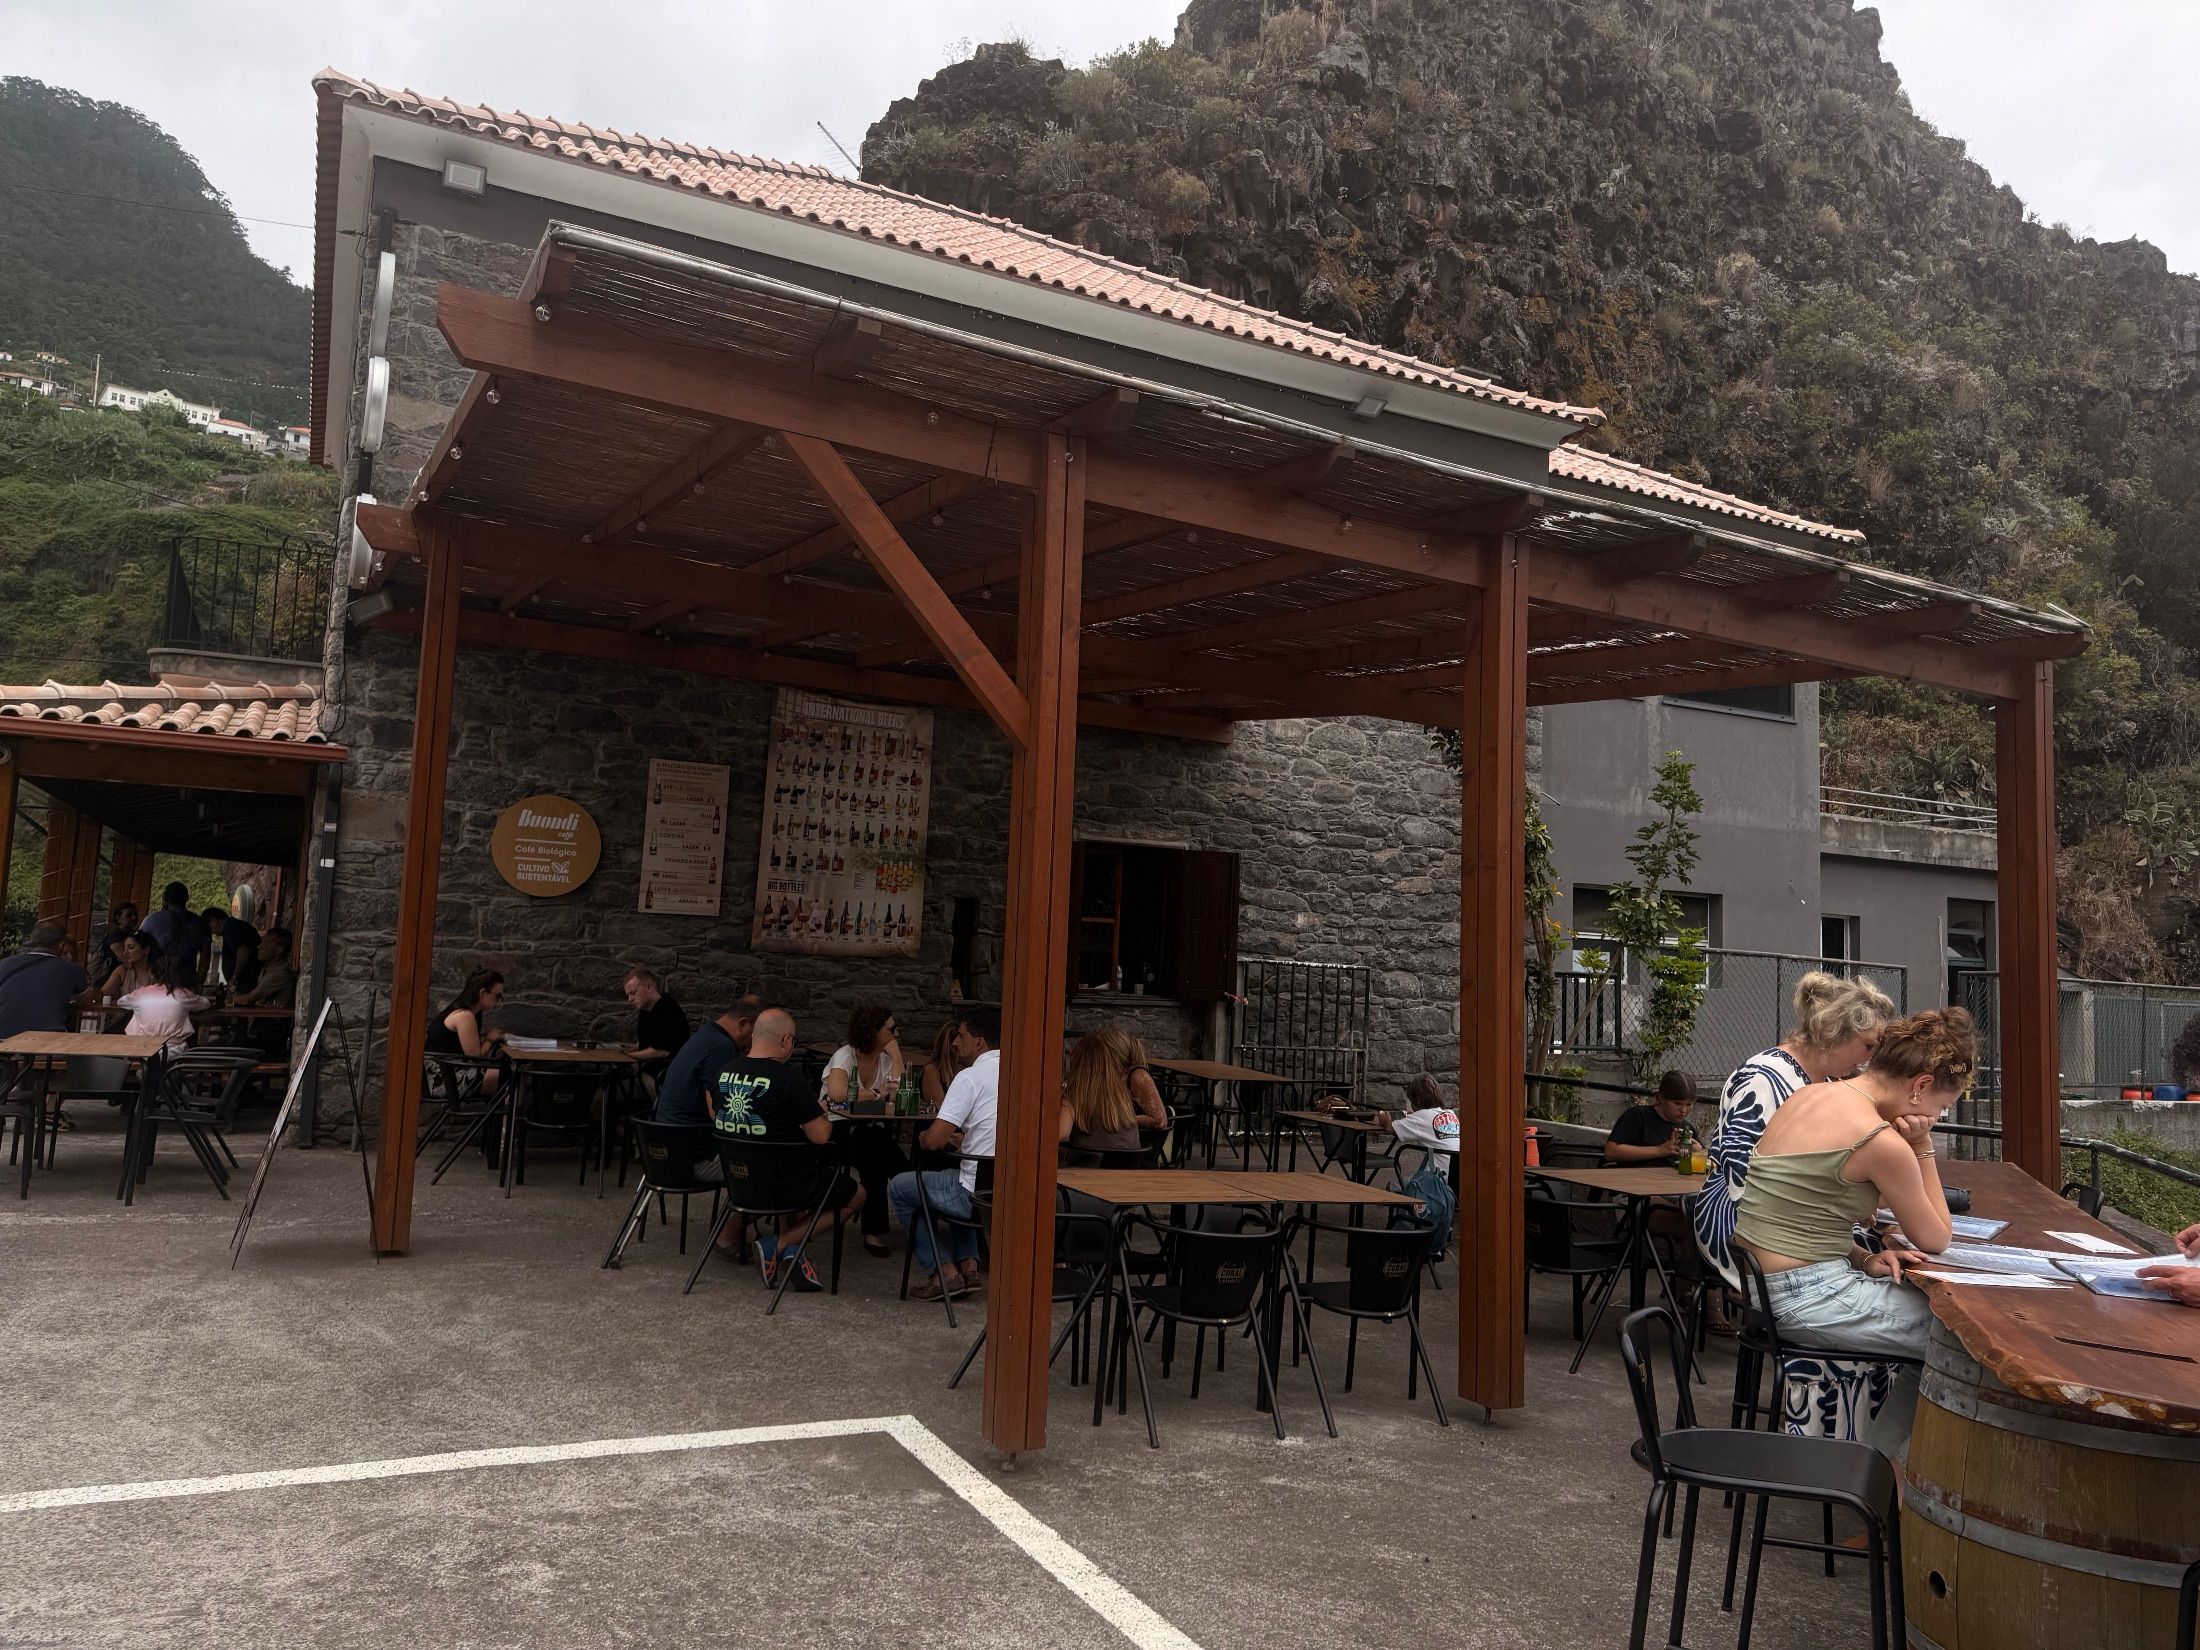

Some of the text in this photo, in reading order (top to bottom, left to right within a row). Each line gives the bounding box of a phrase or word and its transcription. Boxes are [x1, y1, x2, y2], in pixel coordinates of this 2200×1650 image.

[804, 701, 905, 729] INTERNATIONAL BEERS
[515, 844, 577, 857] Café Biológico
[517, 863, 550, 872] CULTIVO
[516, 872, 571, 883] SUSTENTÁVEL
[768, 880, 806, 893] BIG BOTTLES
[718, 1072, 771, 1090] BILLA
